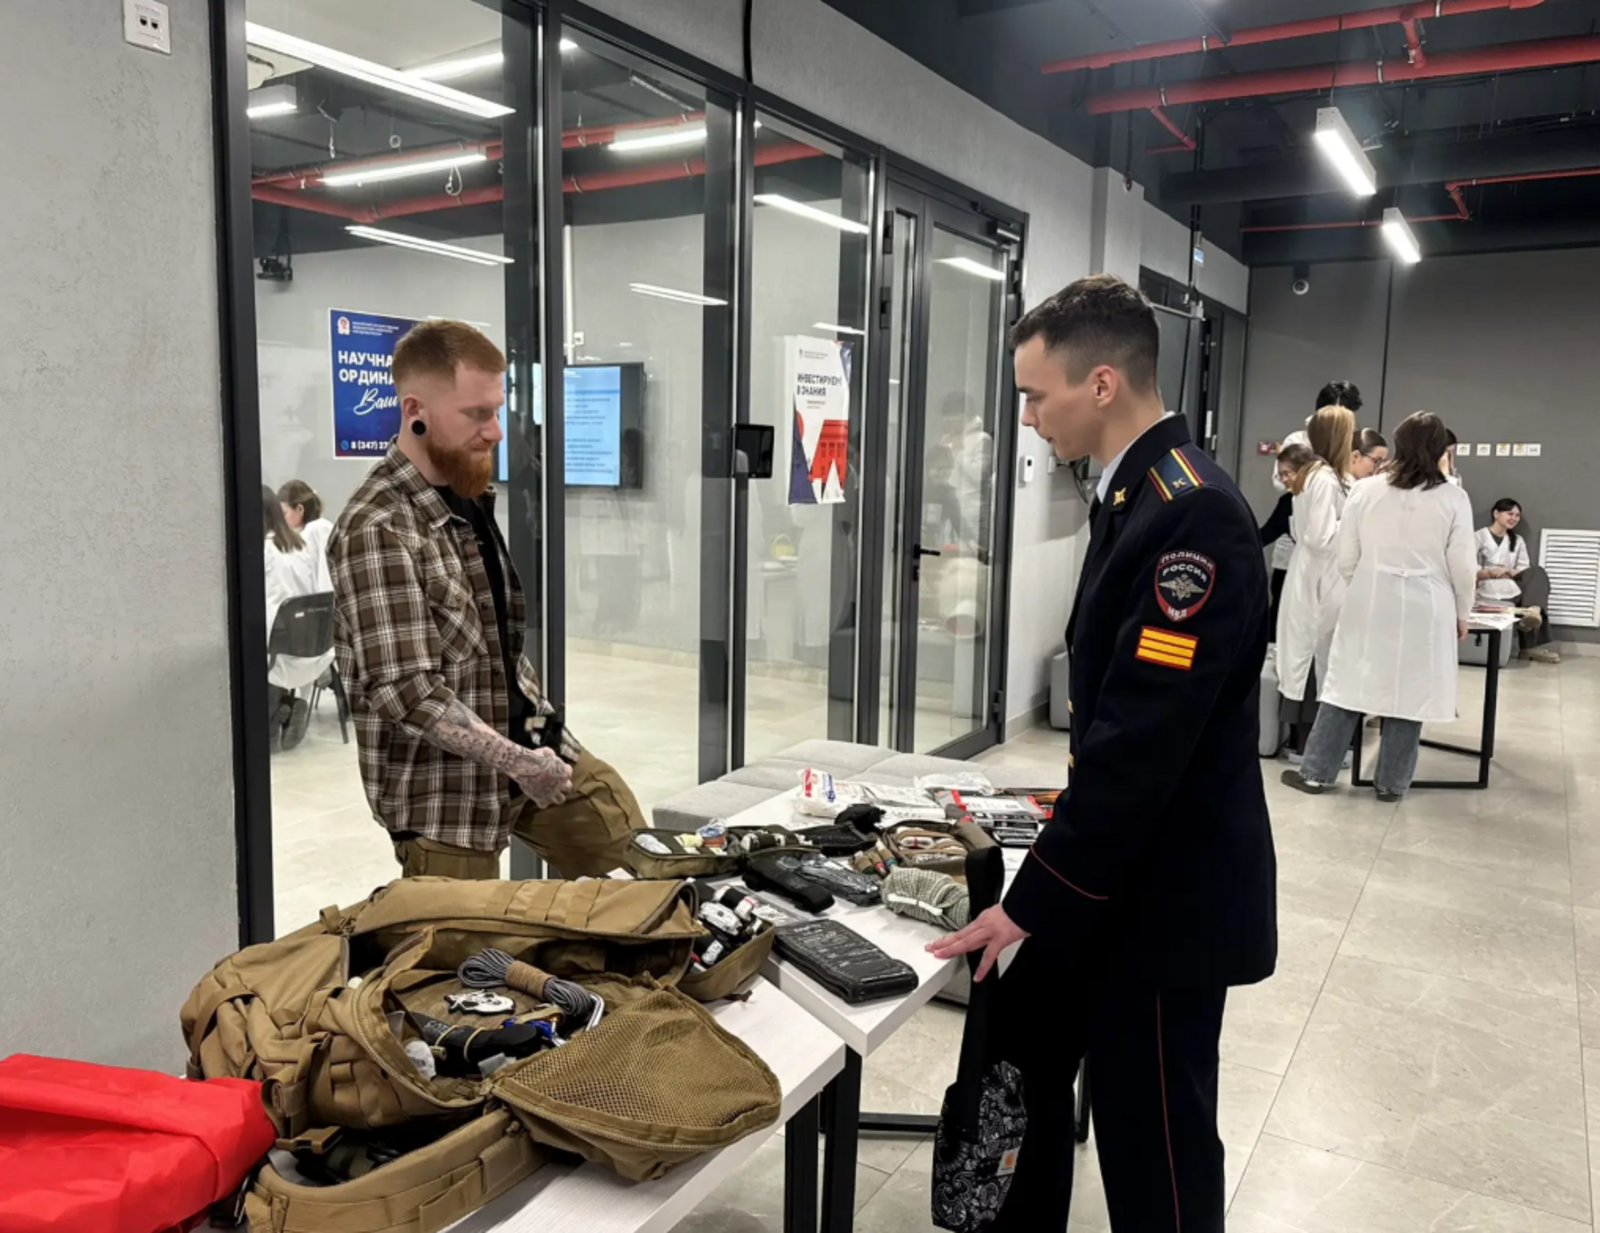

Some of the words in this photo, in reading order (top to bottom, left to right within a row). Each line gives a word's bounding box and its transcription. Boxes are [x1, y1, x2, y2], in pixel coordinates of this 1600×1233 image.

[338, 350, 393, 367] НАУЧНА
[339, 368, 394, 385] ОРДИНА
[802, 386, 826, 396] ЗНАНИЯ
[351, 441, 356, 449] 8
[358, 440, 378, 450] (347)
[379, 441, 389, 449] 27
[1161, 551, 1214, 570] ПОЛИЦИЯ
[1162, 563, 1207, 582] РОССИЯ
